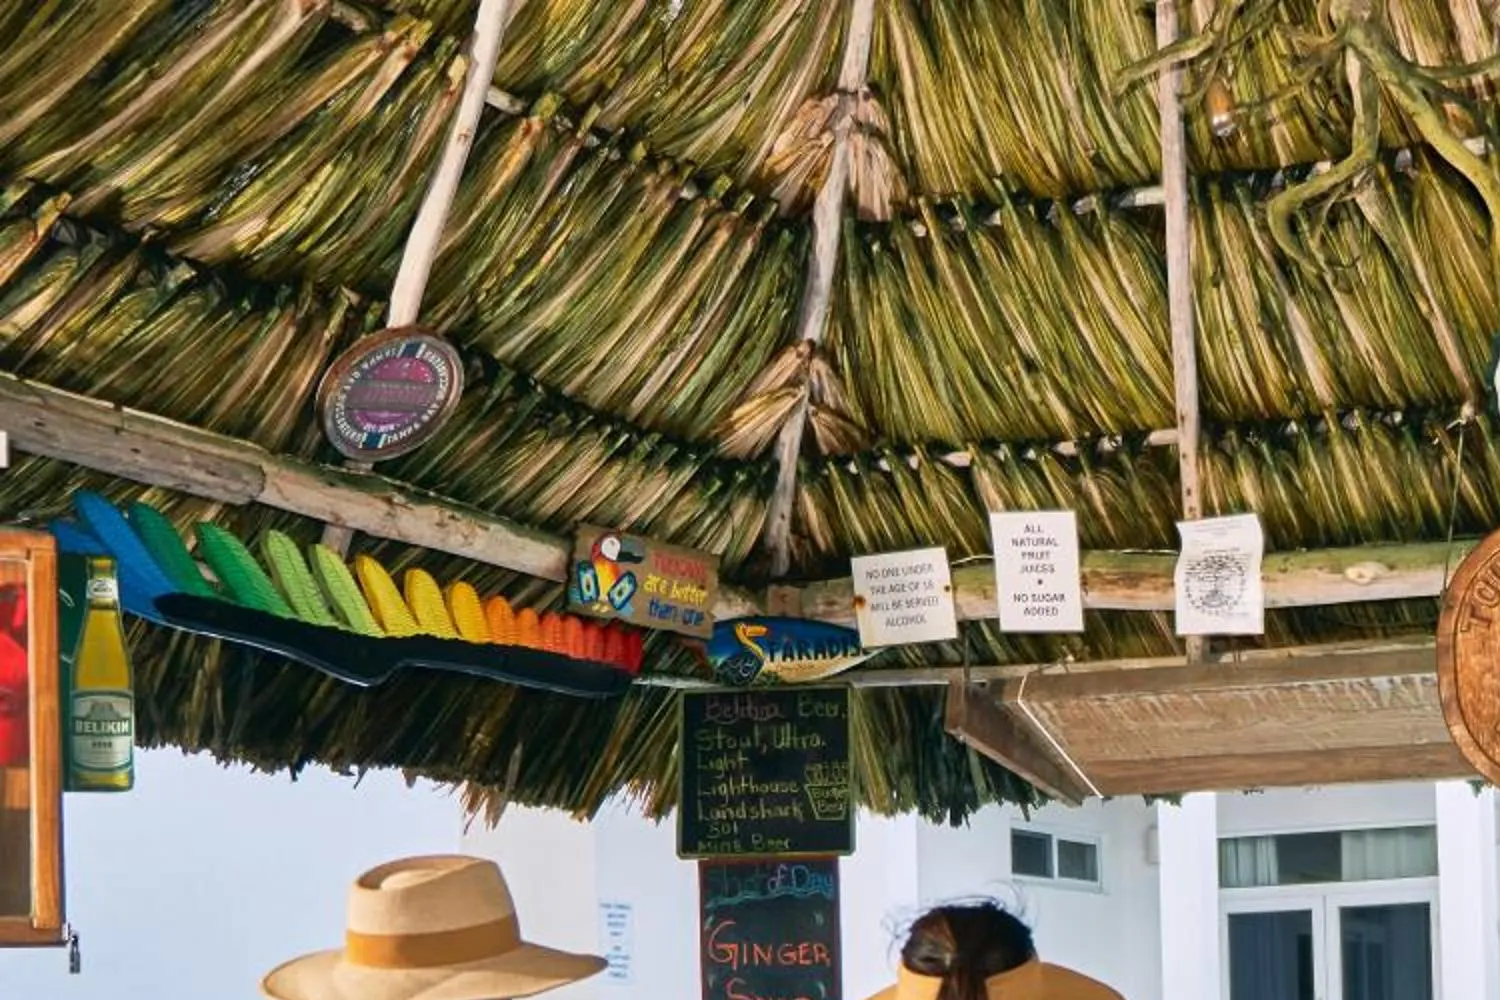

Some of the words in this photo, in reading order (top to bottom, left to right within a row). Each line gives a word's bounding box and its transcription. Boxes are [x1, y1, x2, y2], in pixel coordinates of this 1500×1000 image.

[1024, 524, 1044, 533] ALL
[1011, 537, 1059, 547] NATURAL
[1021, 551, 1050, 561] FRUIT
[865, 569, 880, 580] NO
[882, 567, 900, 578] ONE
[901, 563, 935, 577] UNDER
[1020, 564, 1055, 574] JUICES
[870, 584, 886, 596] THE
[889, 583, 906, 594] AGE
[908, 581, 920, 592] OF
[870, 600, 890, 611] WILL
[905, 596, 939, 609] SERVED
[1013, 593, 1028, 603] NO
[1031, 593, 1066, 603] SUGAR
[1023, 606, 1059, 617] ADDED
[885, 614, 928, 628] ALCOHOL
[769, 635, 862, 662] PARADIS
[74, 720, 130, 735] BELIKIN
[708, 920, 831, 971] GINGER
